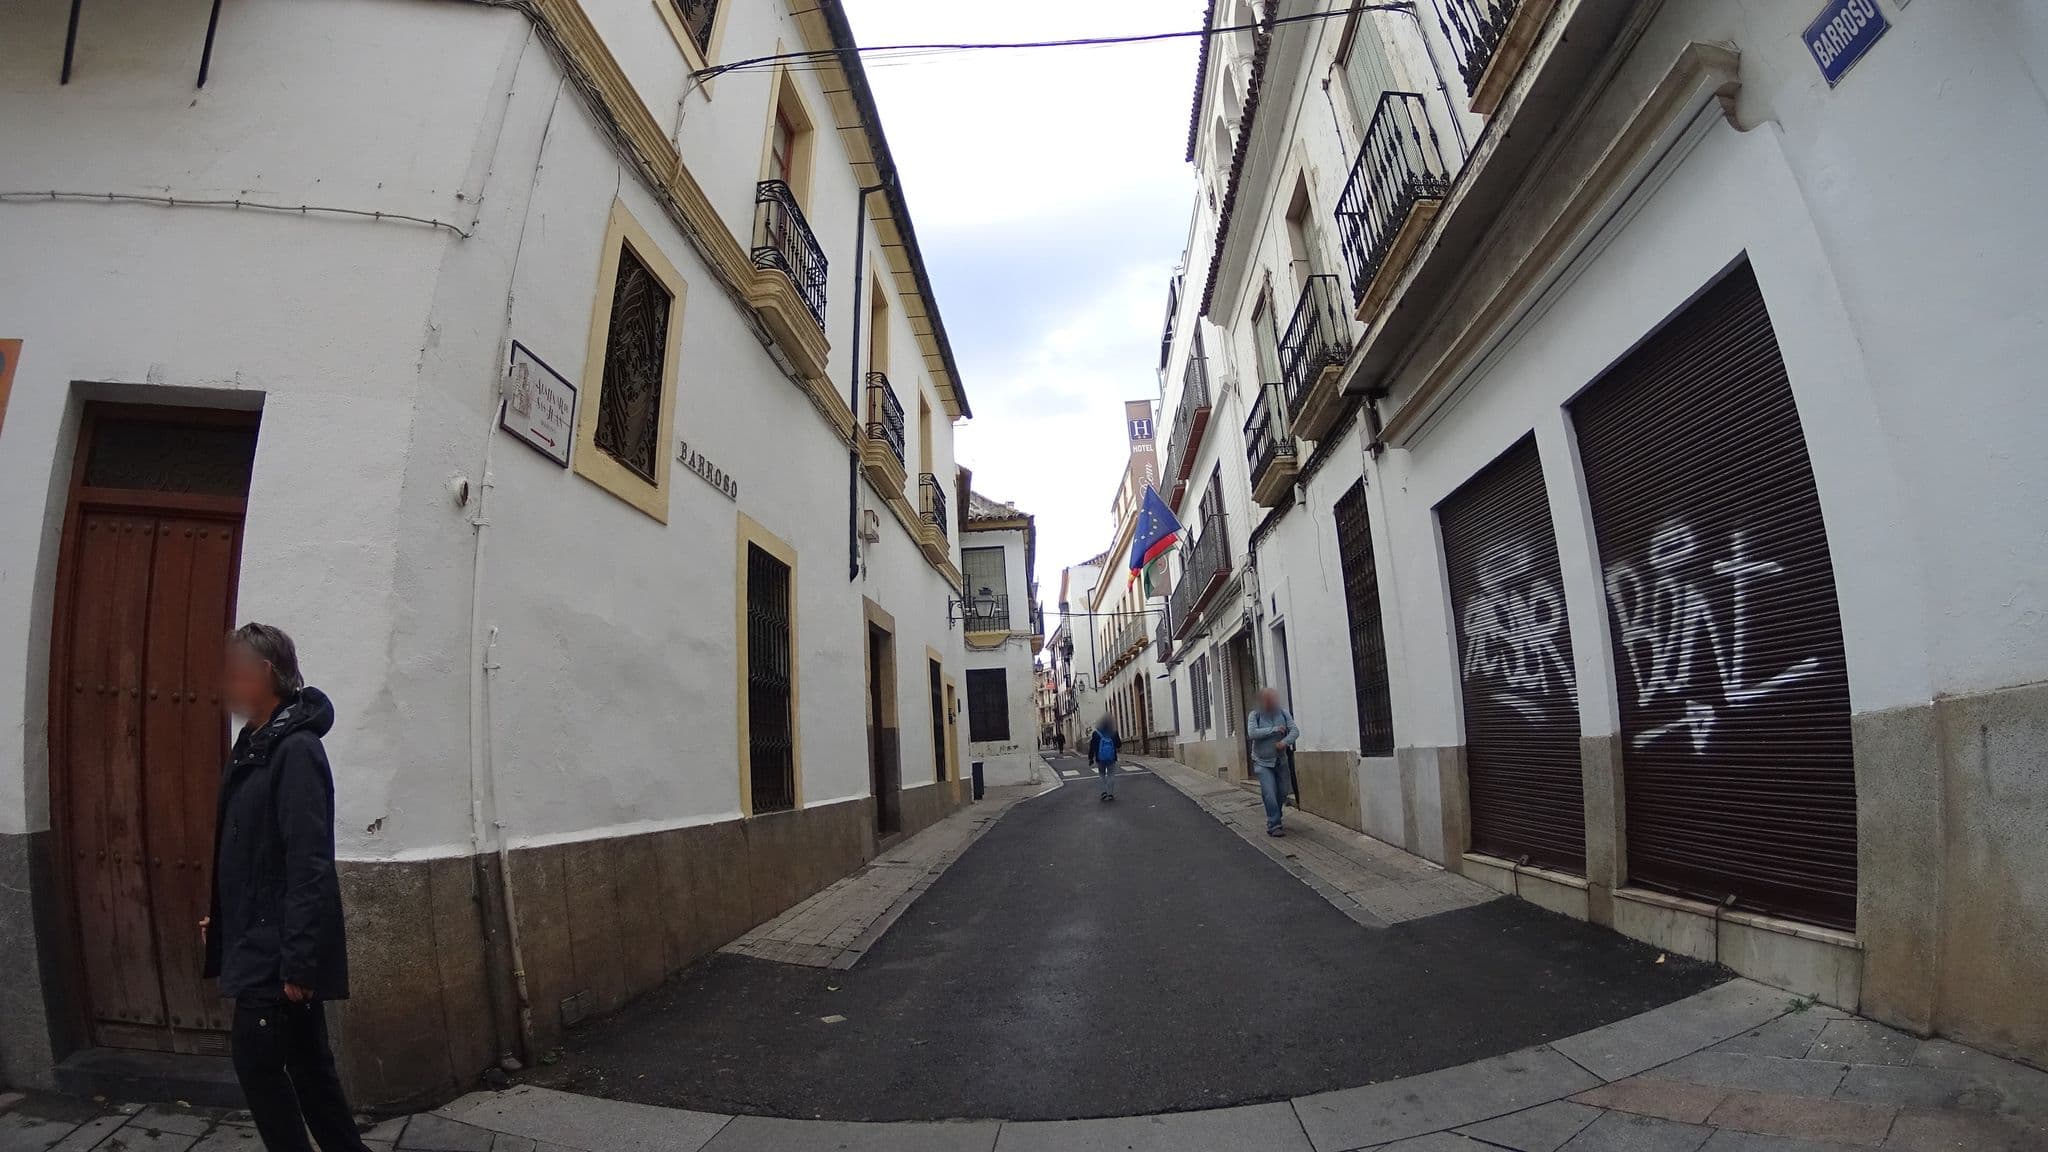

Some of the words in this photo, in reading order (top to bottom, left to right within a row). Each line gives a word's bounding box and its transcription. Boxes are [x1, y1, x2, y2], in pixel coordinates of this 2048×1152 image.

[1813, 0, 1875, 69] BARROSO
[1133, 420, 1150, 437] H
[1132, 444, 1154, 453] HOTEL
[679, 440, 738, 498] BARROSO
